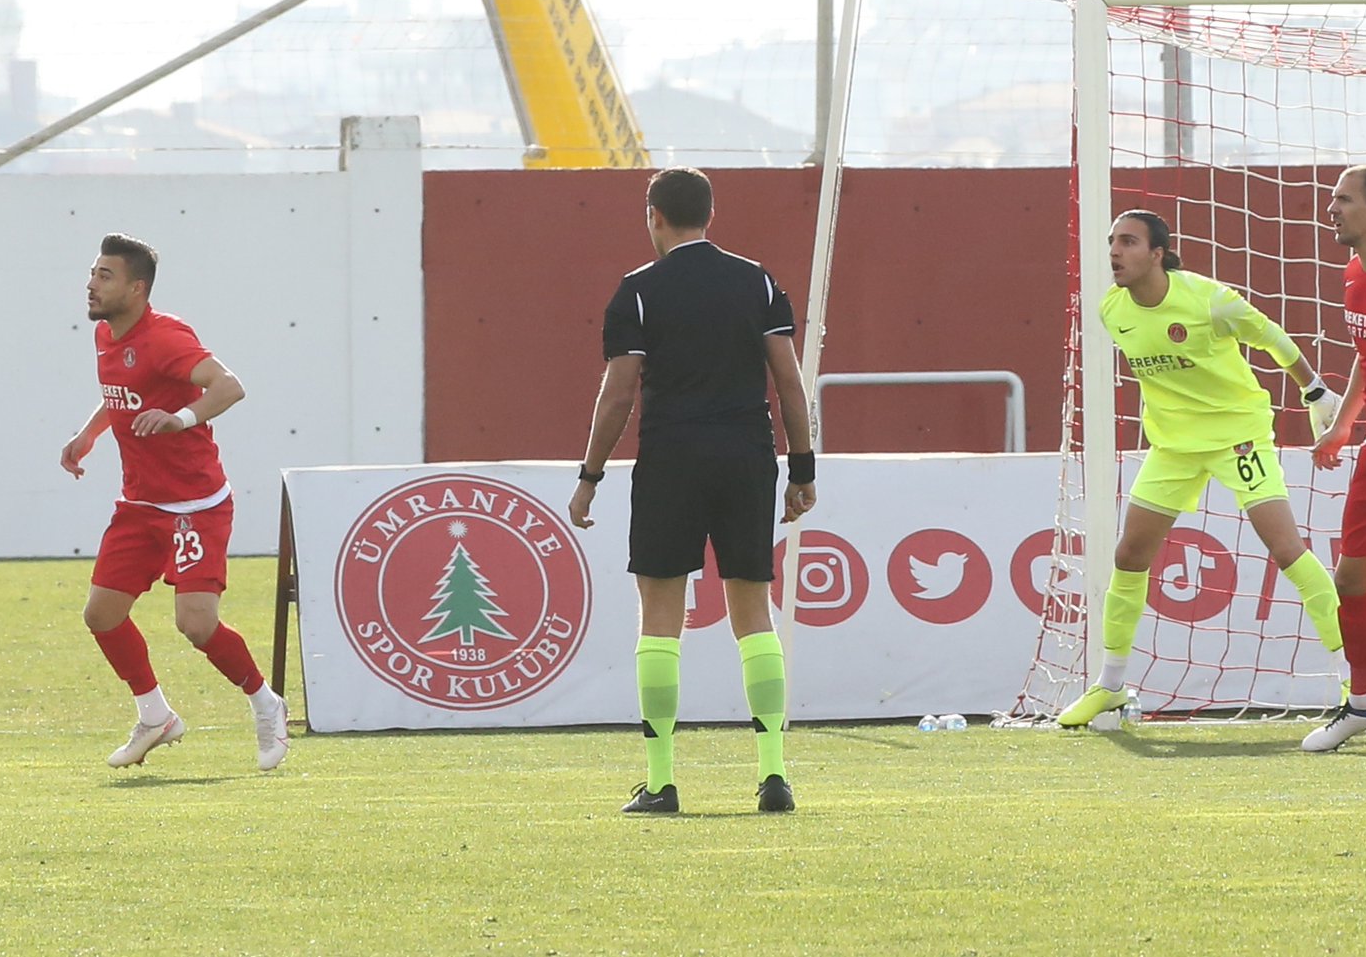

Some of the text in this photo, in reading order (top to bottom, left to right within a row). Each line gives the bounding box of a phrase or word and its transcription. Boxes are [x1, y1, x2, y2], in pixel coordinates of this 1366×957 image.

[1237, 451, 1266, 482] 61
[352, 488, 563, 564] ÜMRANİYE
[173, 530, 204, 565] 23
[357, 613, 573, 699] SPOR KULÜBÜ
[451, 648, 486, 662] 1938
